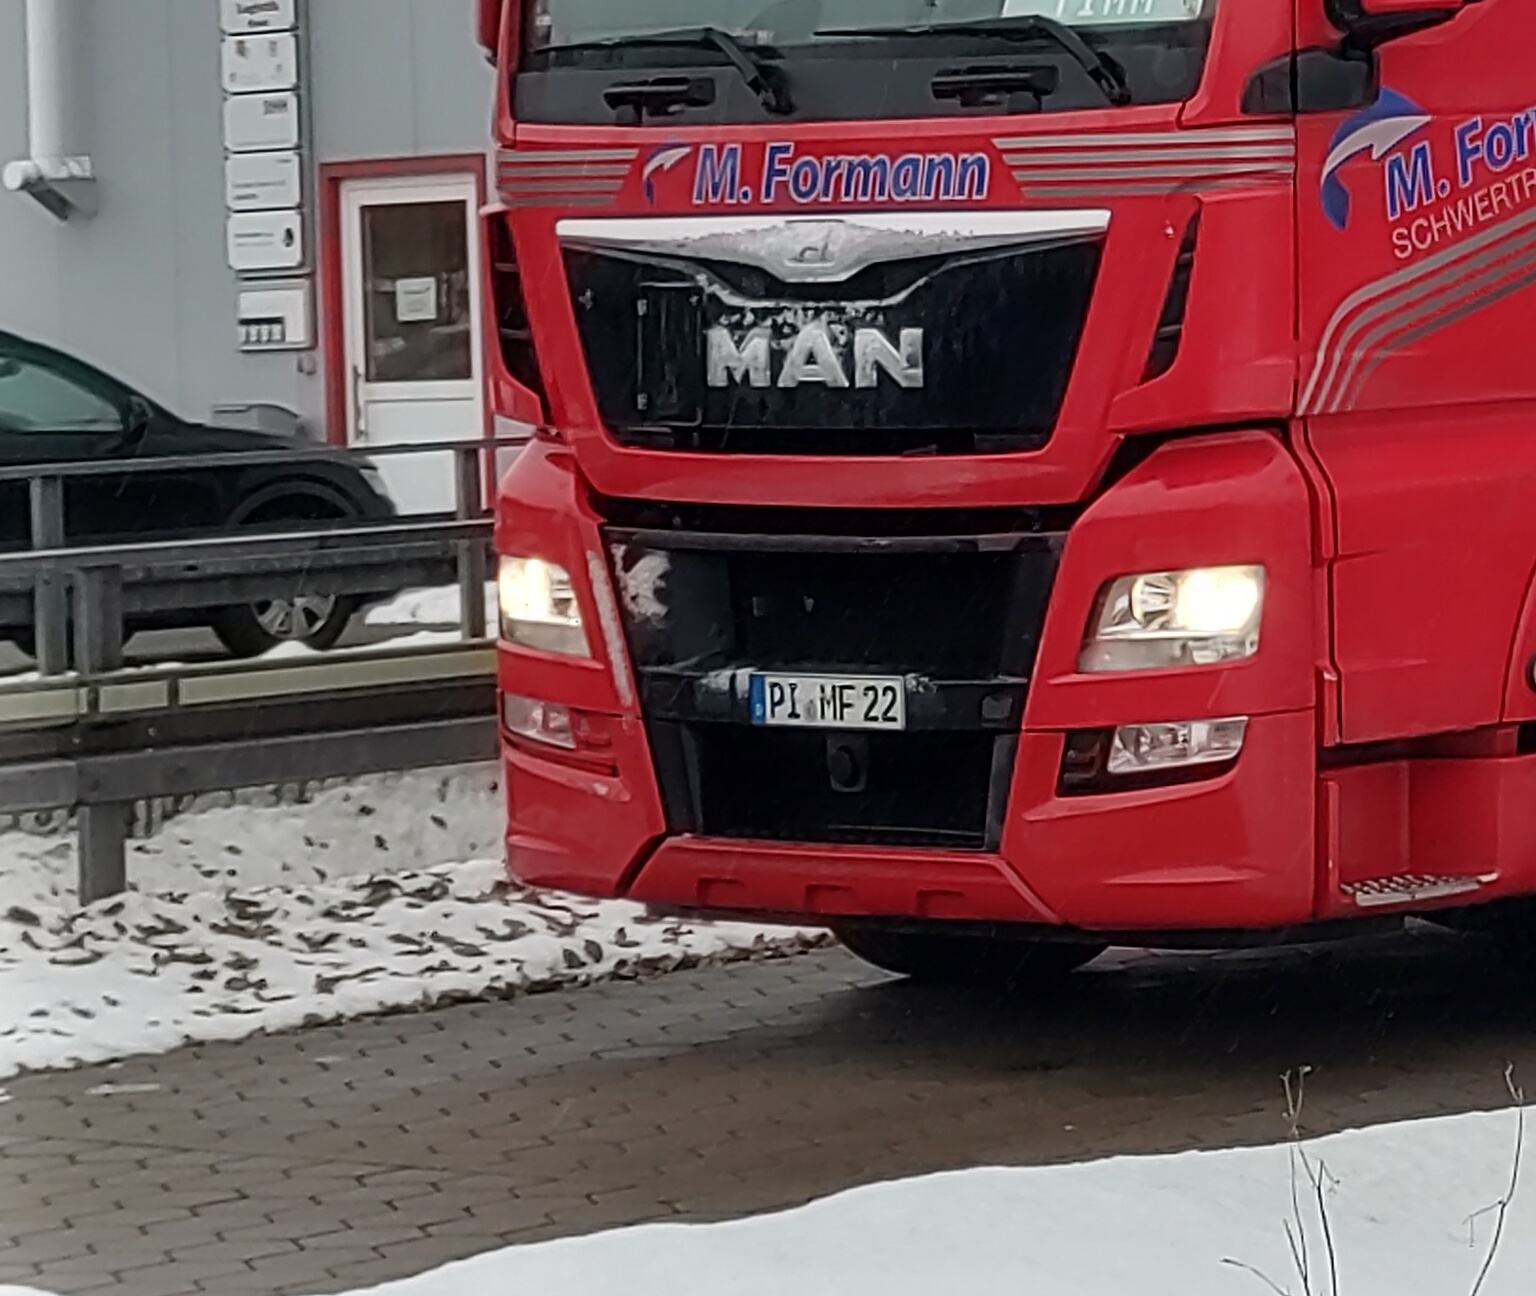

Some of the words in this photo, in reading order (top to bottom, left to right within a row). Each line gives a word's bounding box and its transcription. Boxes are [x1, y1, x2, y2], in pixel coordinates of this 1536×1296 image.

[693, 143, 753, 204] M.
[762, 142, 991, 203] Formann
[1384, 140, 1451, 221] M.
[705, 320, 924, 388] MAN
[768, 682, 800, 719] PI
[819, 684, 855, 720] MF
[863, 685, 898, 722] 22
